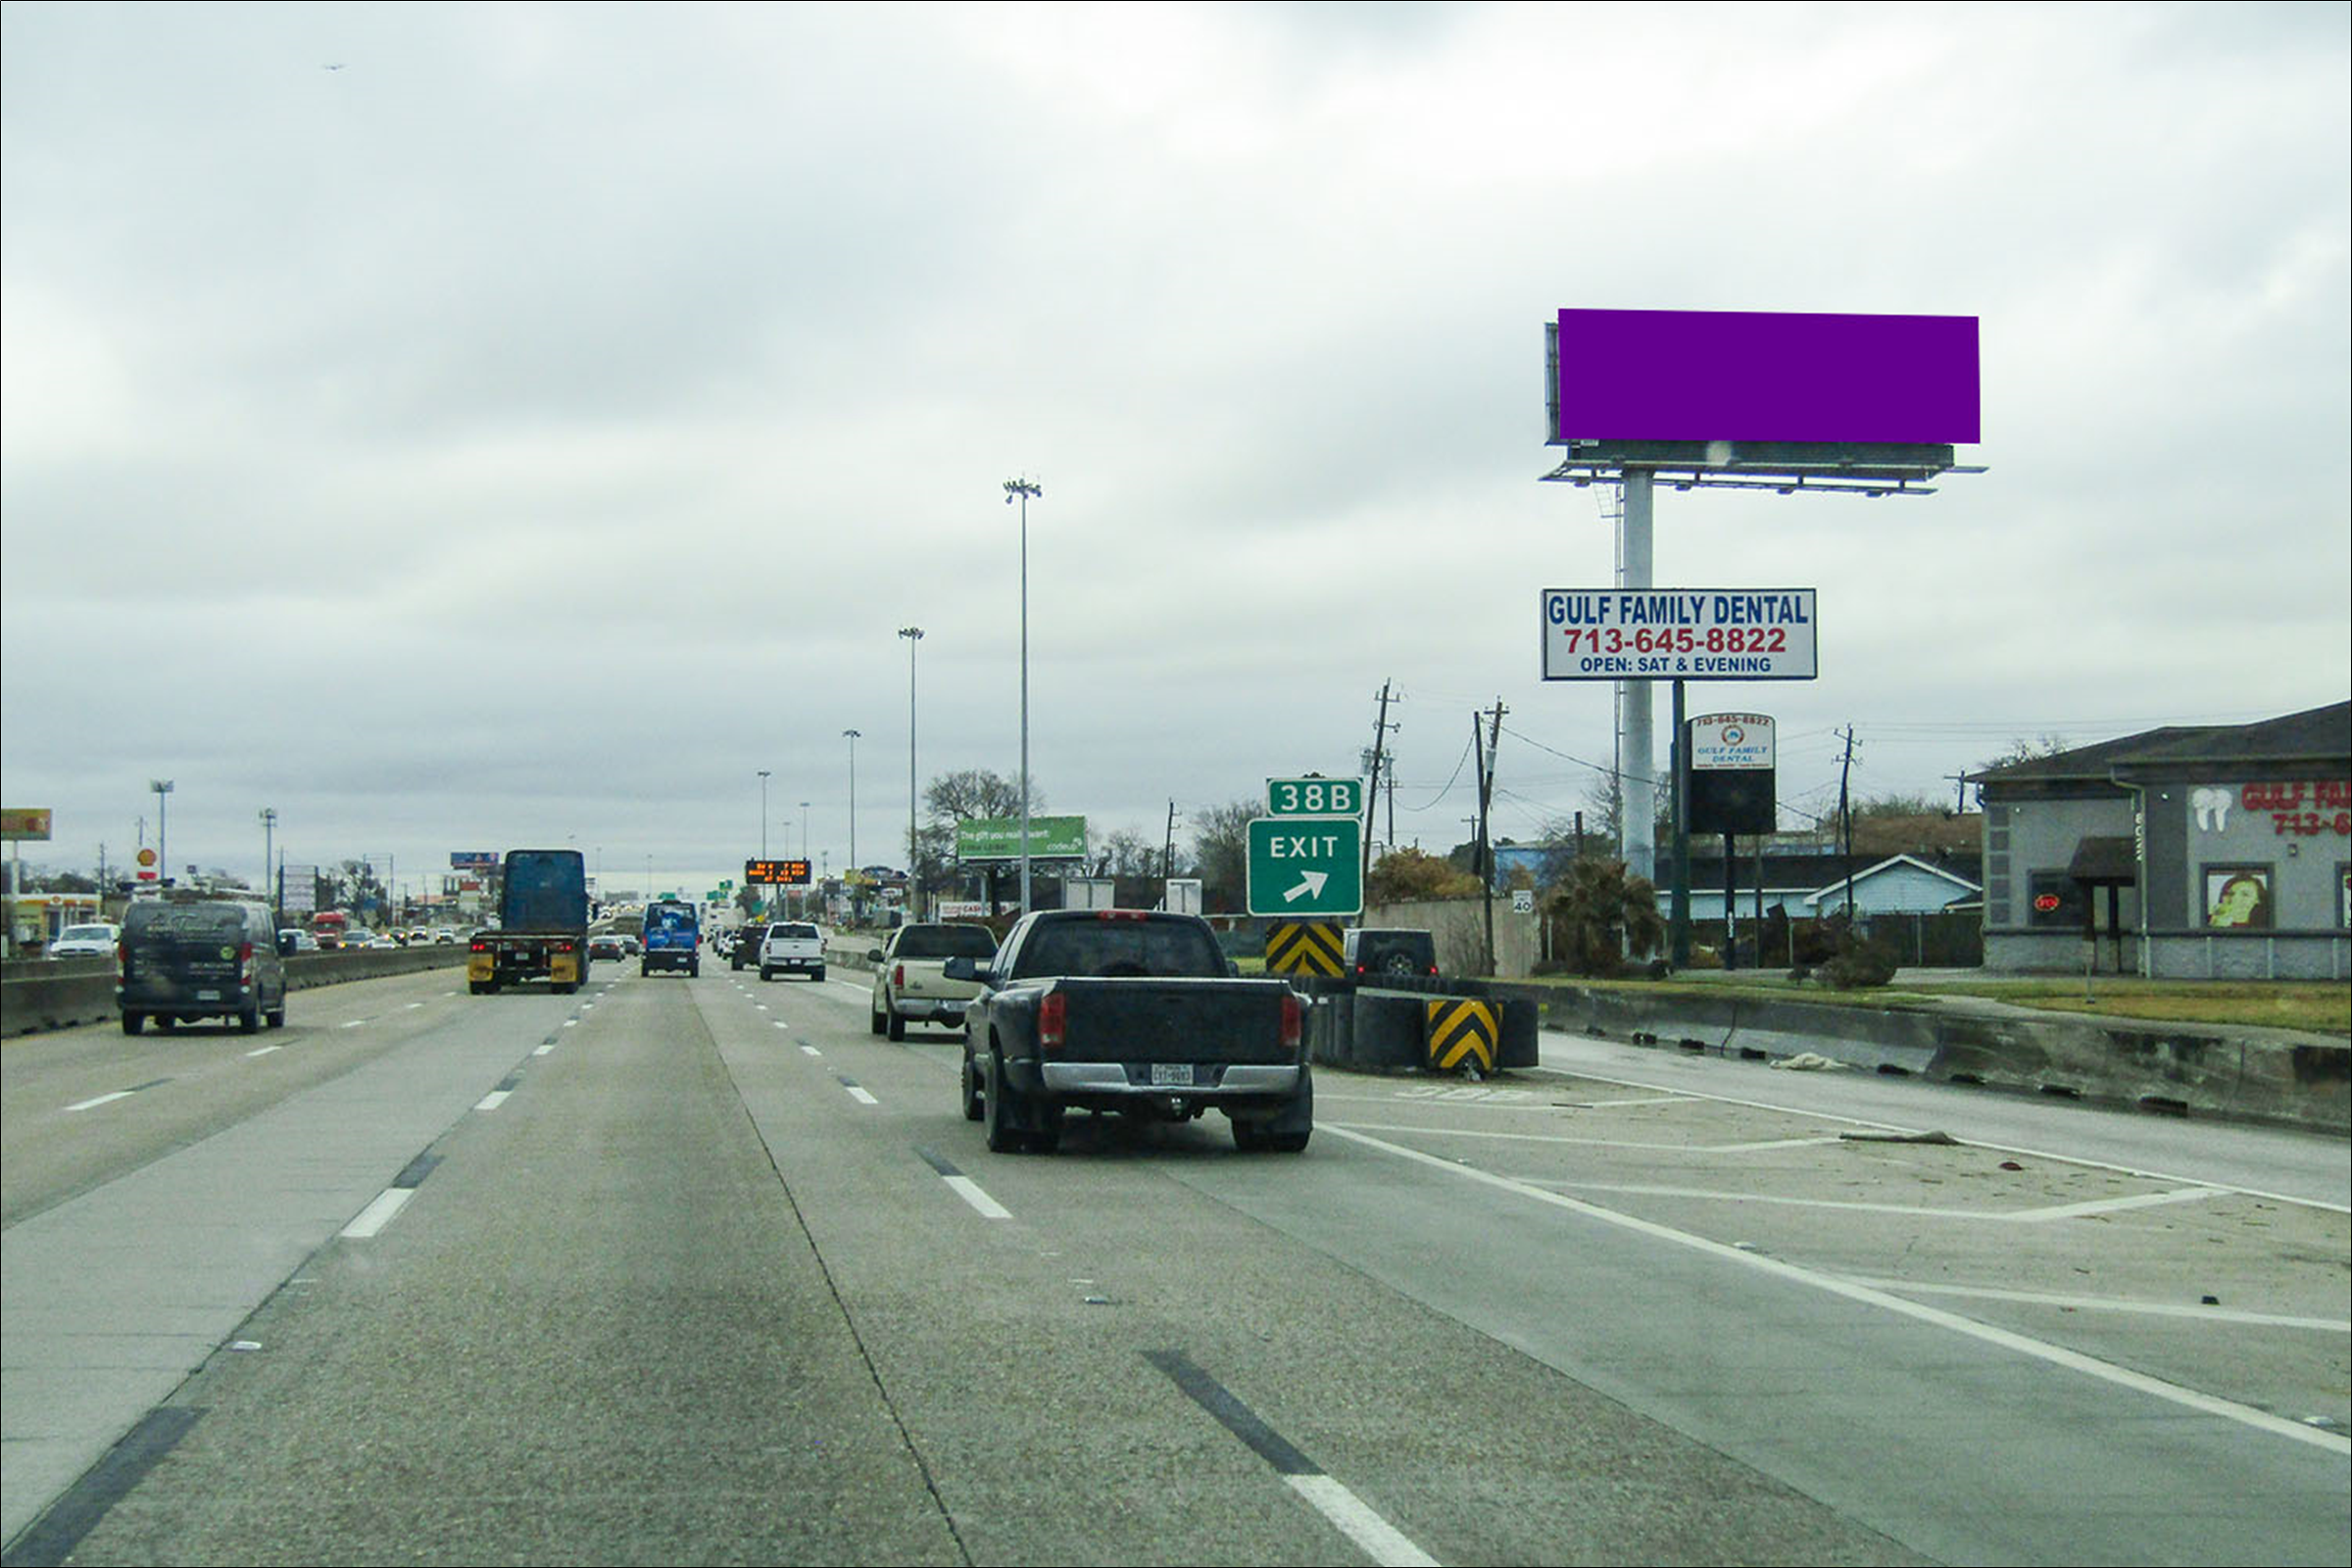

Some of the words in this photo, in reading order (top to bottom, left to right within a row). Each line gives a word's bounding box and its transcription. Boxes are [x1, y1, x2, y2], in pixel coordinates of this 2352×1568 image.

[1548, 595, 1612, 625] GULF
[1620, 595, 1706, 625] FAMILY
[1714, 594, 1809, 624] DENTAL
[1563, 627, 1787, 654] 713-645-8822
[1580, 657, 1633, 672] OPEN:
[1638, 657, 1670, 672] SAT
[1675, 657, 1689, 672] &
[1694, 657, 1772, 672] EVENING
[1696, 715, 1770, 727] 713-645-8822
[1697, 746, 1726, 755] GULF
[1728, 746, 1768, 755] FAMILY
[1280, 783, 1351, 811] 38B
[1269, 836, 1339, 858] EXIT
[1514, 902, 1532, 911] 40
